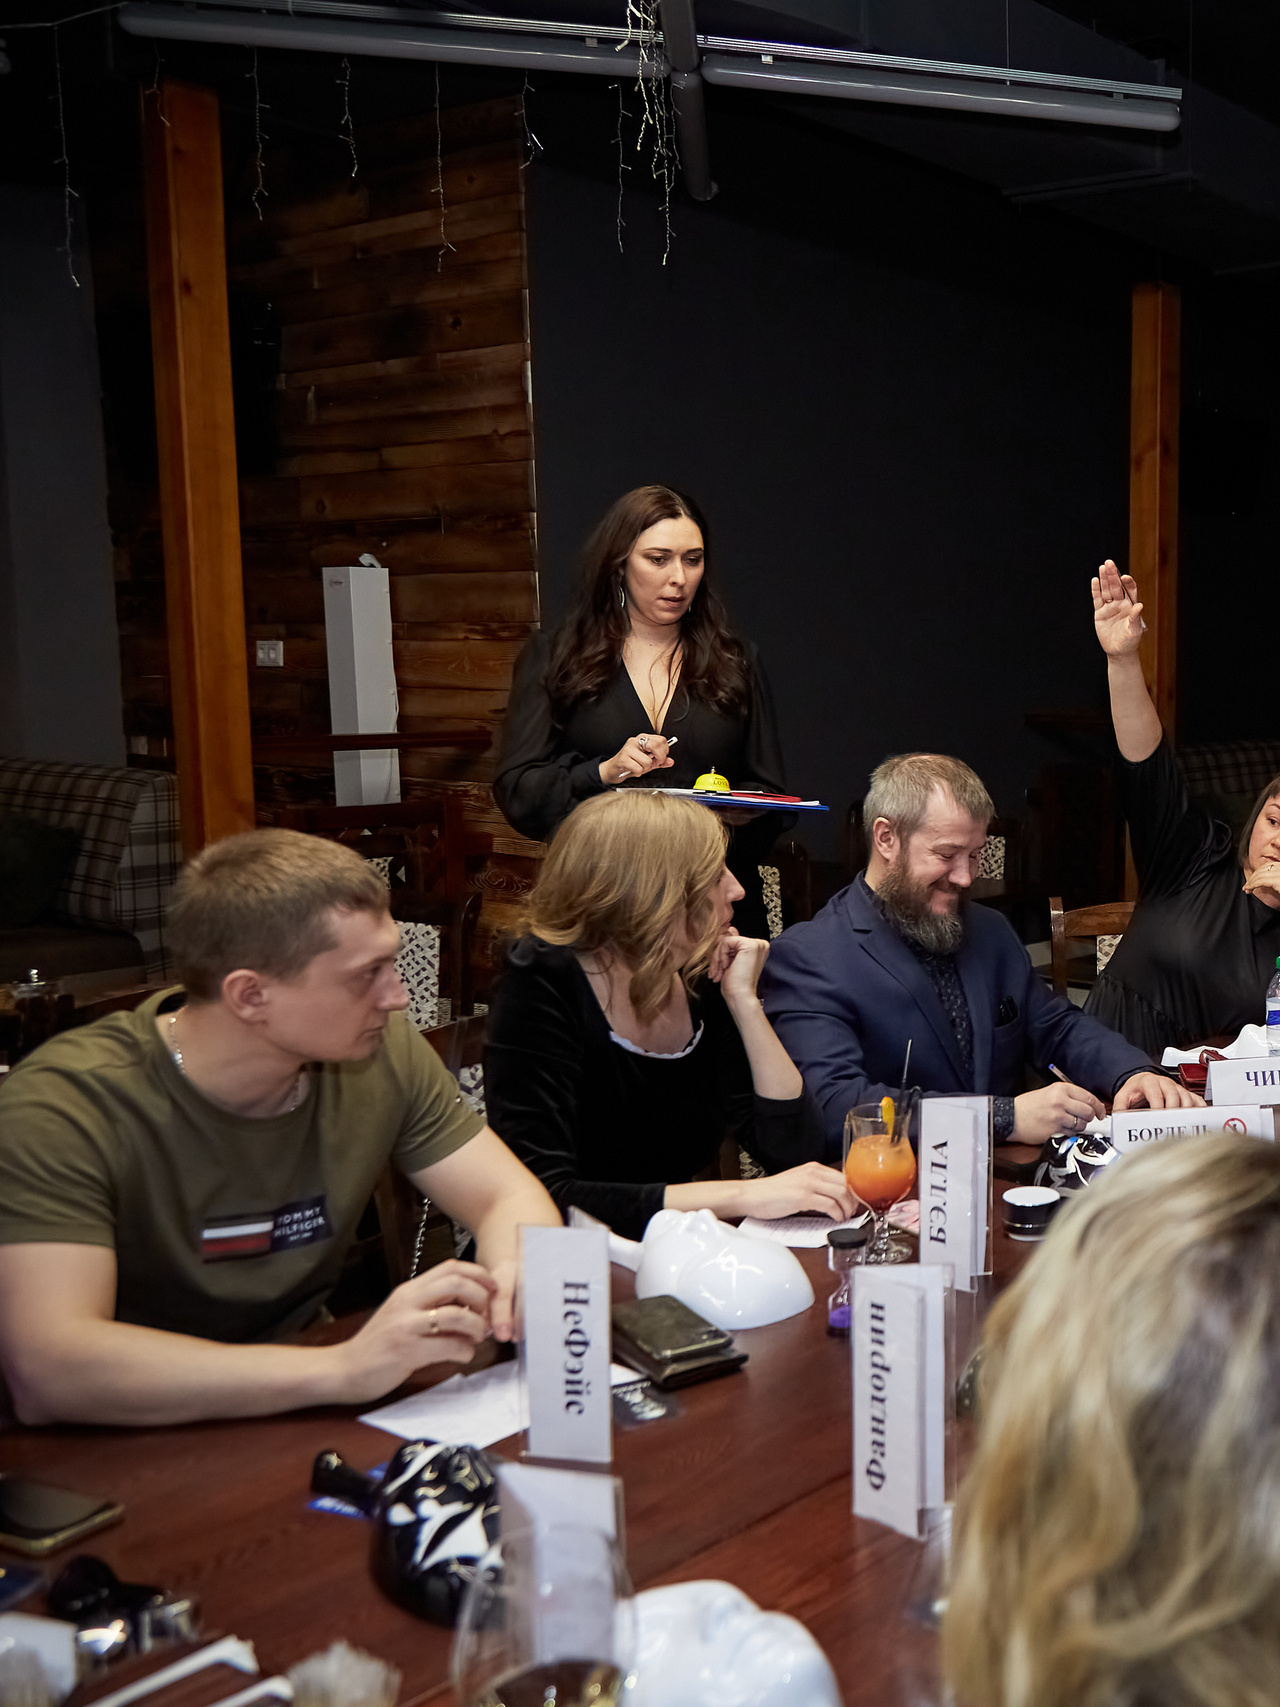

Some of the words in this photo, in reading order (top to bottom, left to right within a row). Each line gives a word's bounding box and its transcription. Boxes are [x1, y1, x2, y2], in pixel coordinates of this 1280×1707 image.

[273, 1215, 326, 1238] HILFIGER
[277, 1205, 321, 1226] TOMMY
[929, 1140, 948, 1246] БЭЛЛА
[563, 1281, 592, 1417] НеФэйс
[866, 1301, 892, 1492] Фандорин
